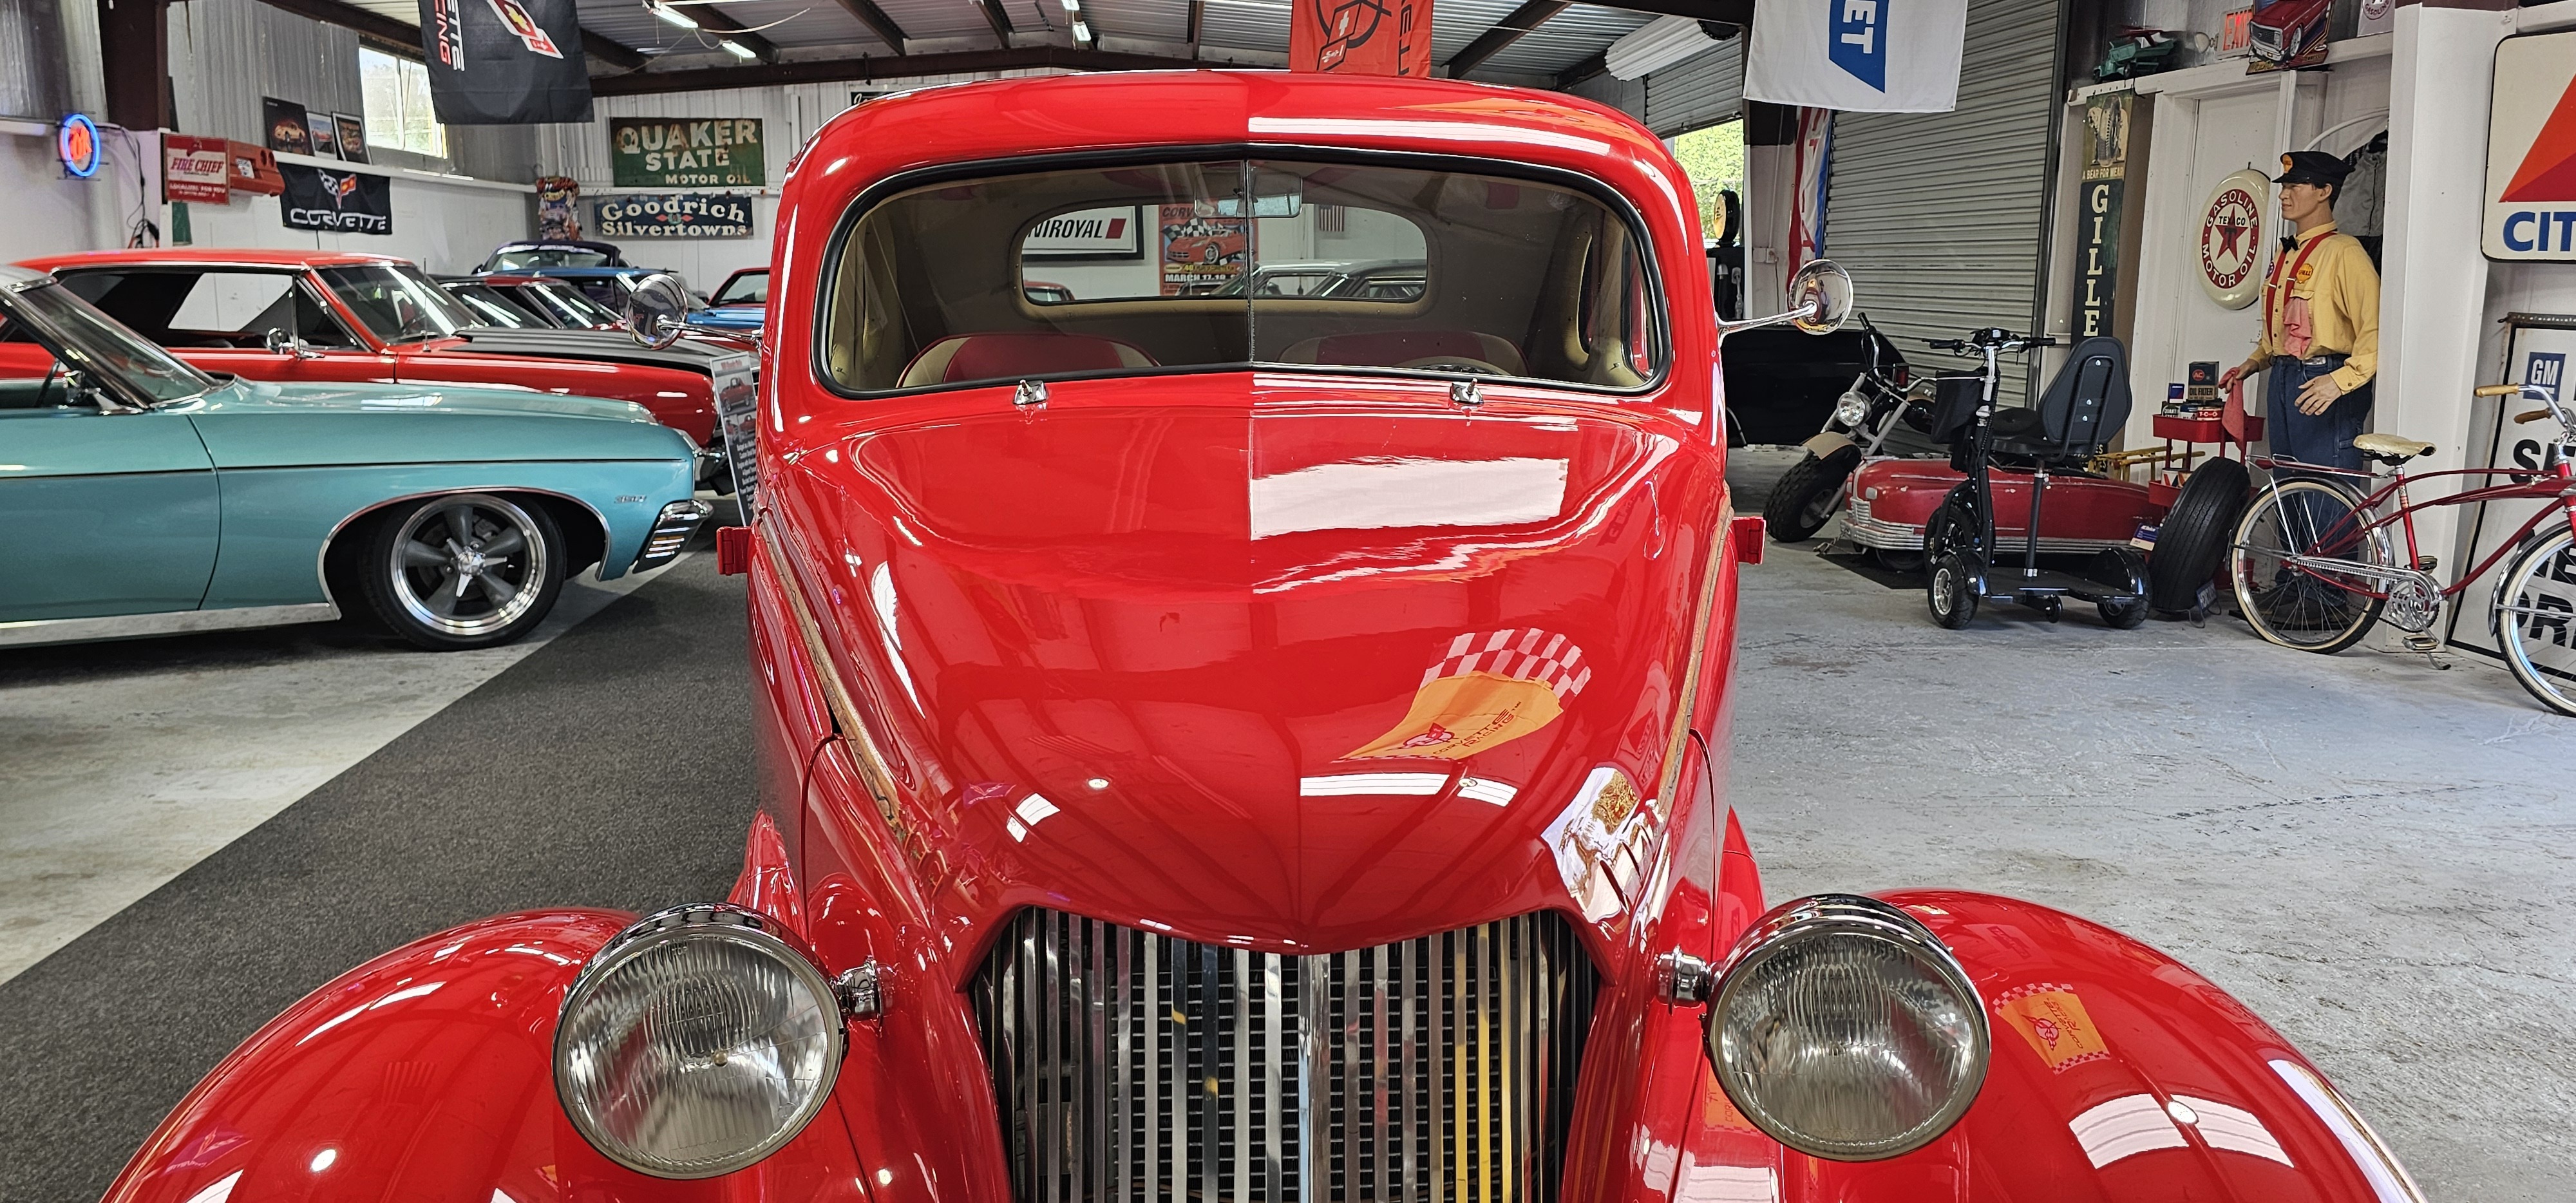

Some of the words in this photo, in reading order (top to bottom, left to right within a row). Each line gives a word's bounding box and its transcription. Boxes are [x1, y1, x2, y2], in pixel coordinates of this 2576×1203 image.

[616, 120, 758, 154] QUAKER
[171, 157, 194, 170] FIRE
[195, 159, 224, 173] CHIEF
[645, 149, 730, 171] STATE
[665, 175, 718, 184] MOTOR
[726, 175, 751, 184] OIL
[2087, 169, 2099, 180] BEAR
[2099, 167, 2109, 178] FOR
[290, 208, 386, 231] CORVETTE
[601, 195, 744, 223] Goodrich
[2206, 191, 2258, 229] GASOLINE
[602, 221, 747, 236] Silvertowns
[2503, 211, 2576, 252] CIT
[2202, 245, 2236, 287] MOTOR
[2240, 245, 2257, 276] OIL
[1165, 274, 1200, 282] MARCH
[2530, 359, 2559, 385] GM
[2198, 388, 2213, 396] FILTER
